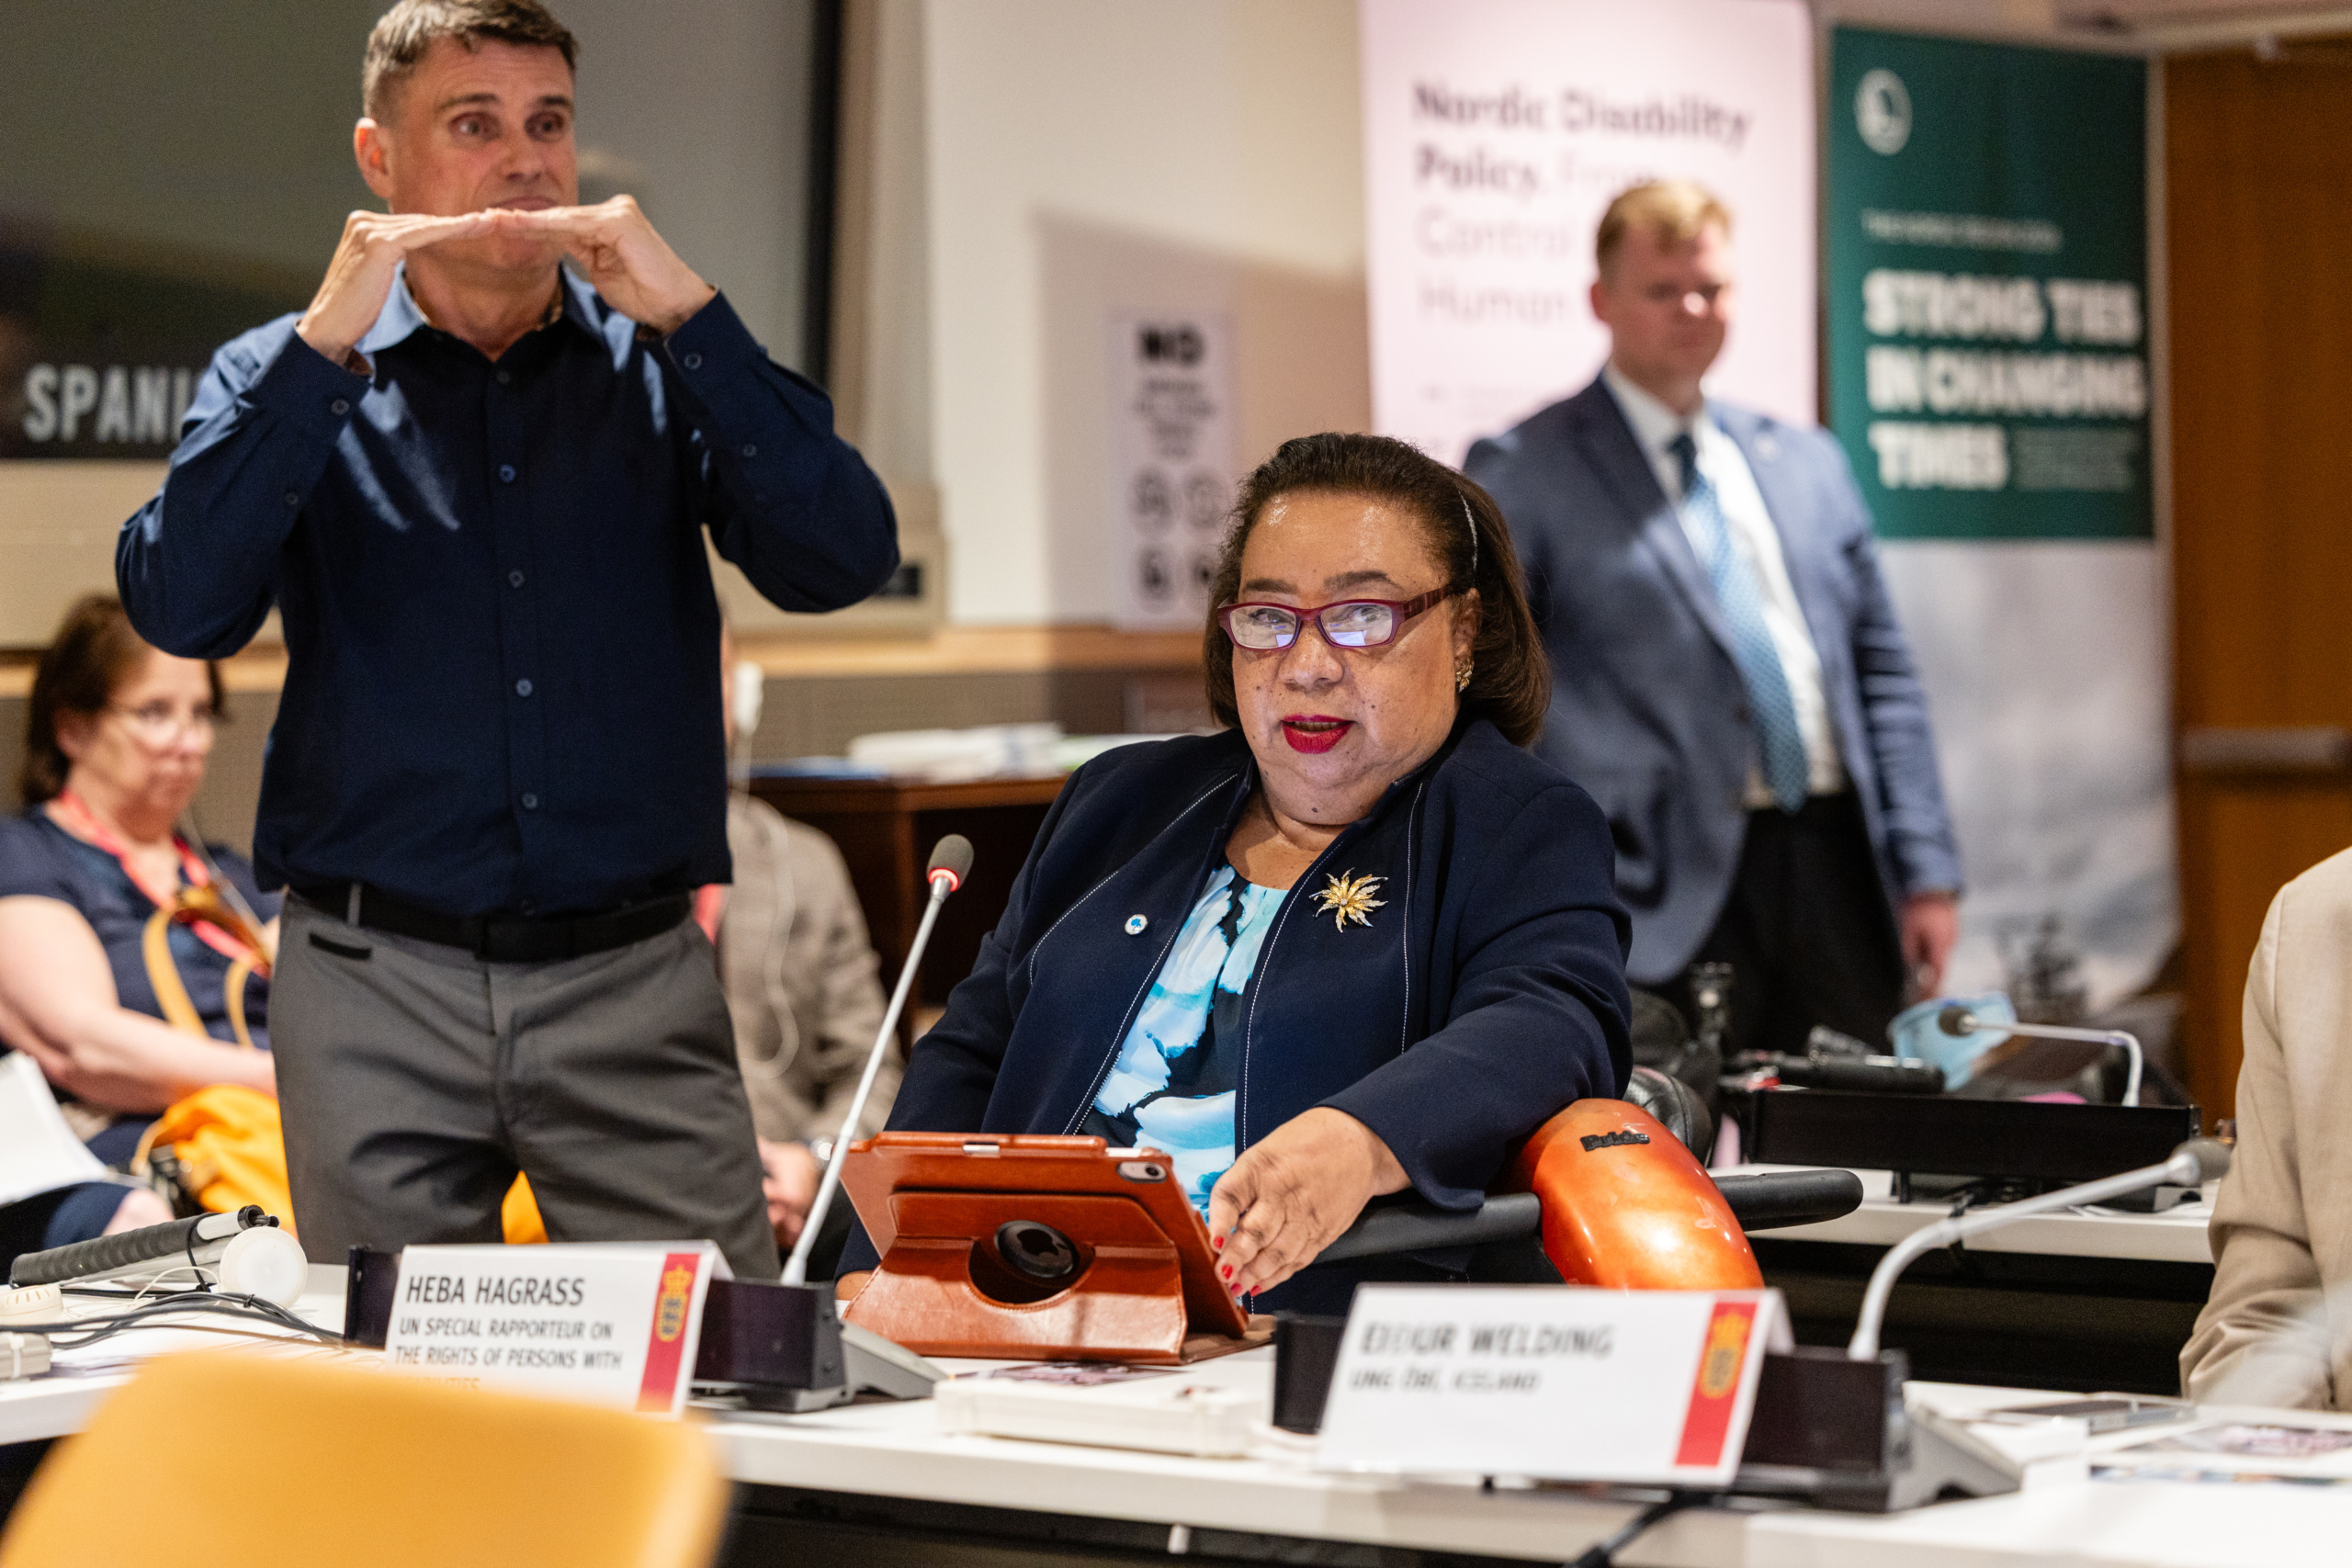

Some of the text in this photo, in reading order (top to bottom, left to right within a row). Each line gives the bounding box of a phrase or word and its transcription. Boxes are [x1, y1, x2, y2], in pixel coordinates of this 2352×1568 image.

[1415, 81, 1753, 149] Nordic Disability
[1419, 278, 1569, 321] Human
[1863, 270, 2142, 344] STRONG TIES
[1866, 346, 2146, 417] IN CHANGING
[23, 363, 194, 444] SPANI
[1867, 423, 2008, 491] TIMES
[1580, 1130, 1651, 1152] Pride
[406, 1275, 585, 1306] HEBA HAGRASS
[400, 1318, 614, 1339] UN SPECIAL RAPPORTEUR ON
[1470, 1324, 1614, 1358] WELDING
[395, 1346, 623, 1370] THE RIGHTS OF PERSONS WITH
